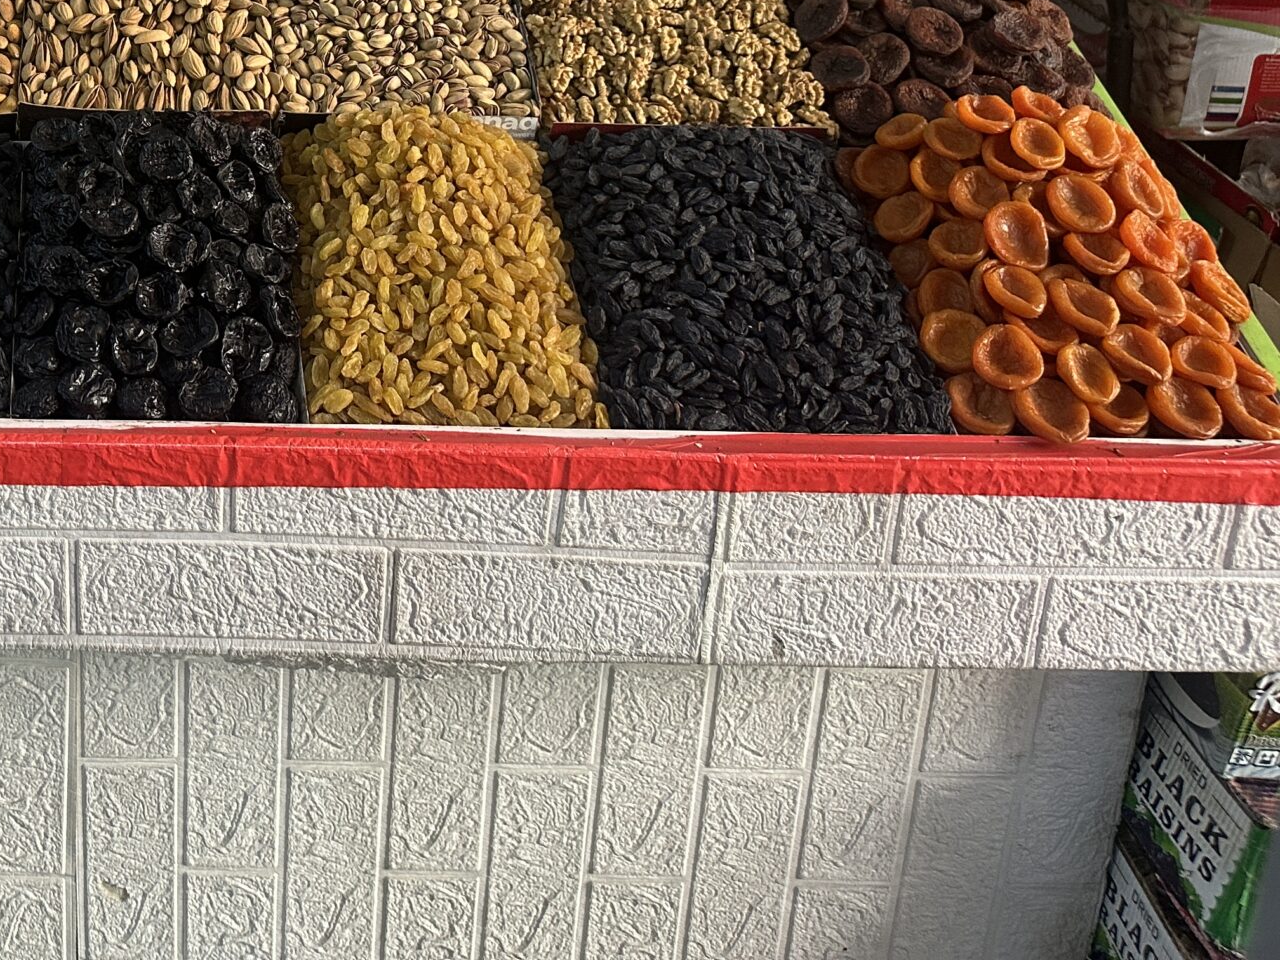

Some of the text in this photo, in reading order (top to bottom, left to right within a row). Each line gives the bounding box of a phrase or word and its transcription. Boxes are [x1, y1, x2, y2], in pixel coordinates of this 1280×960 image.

[1137, 727, 1229, 858] BLACK
[1172, 741, 1208, 790] DRIED
[1128, 758, 1217, 883] RAISINS
[1106, 871, 1160, 960] BLAC
[1131, 889, 1160, 941] DRIED
